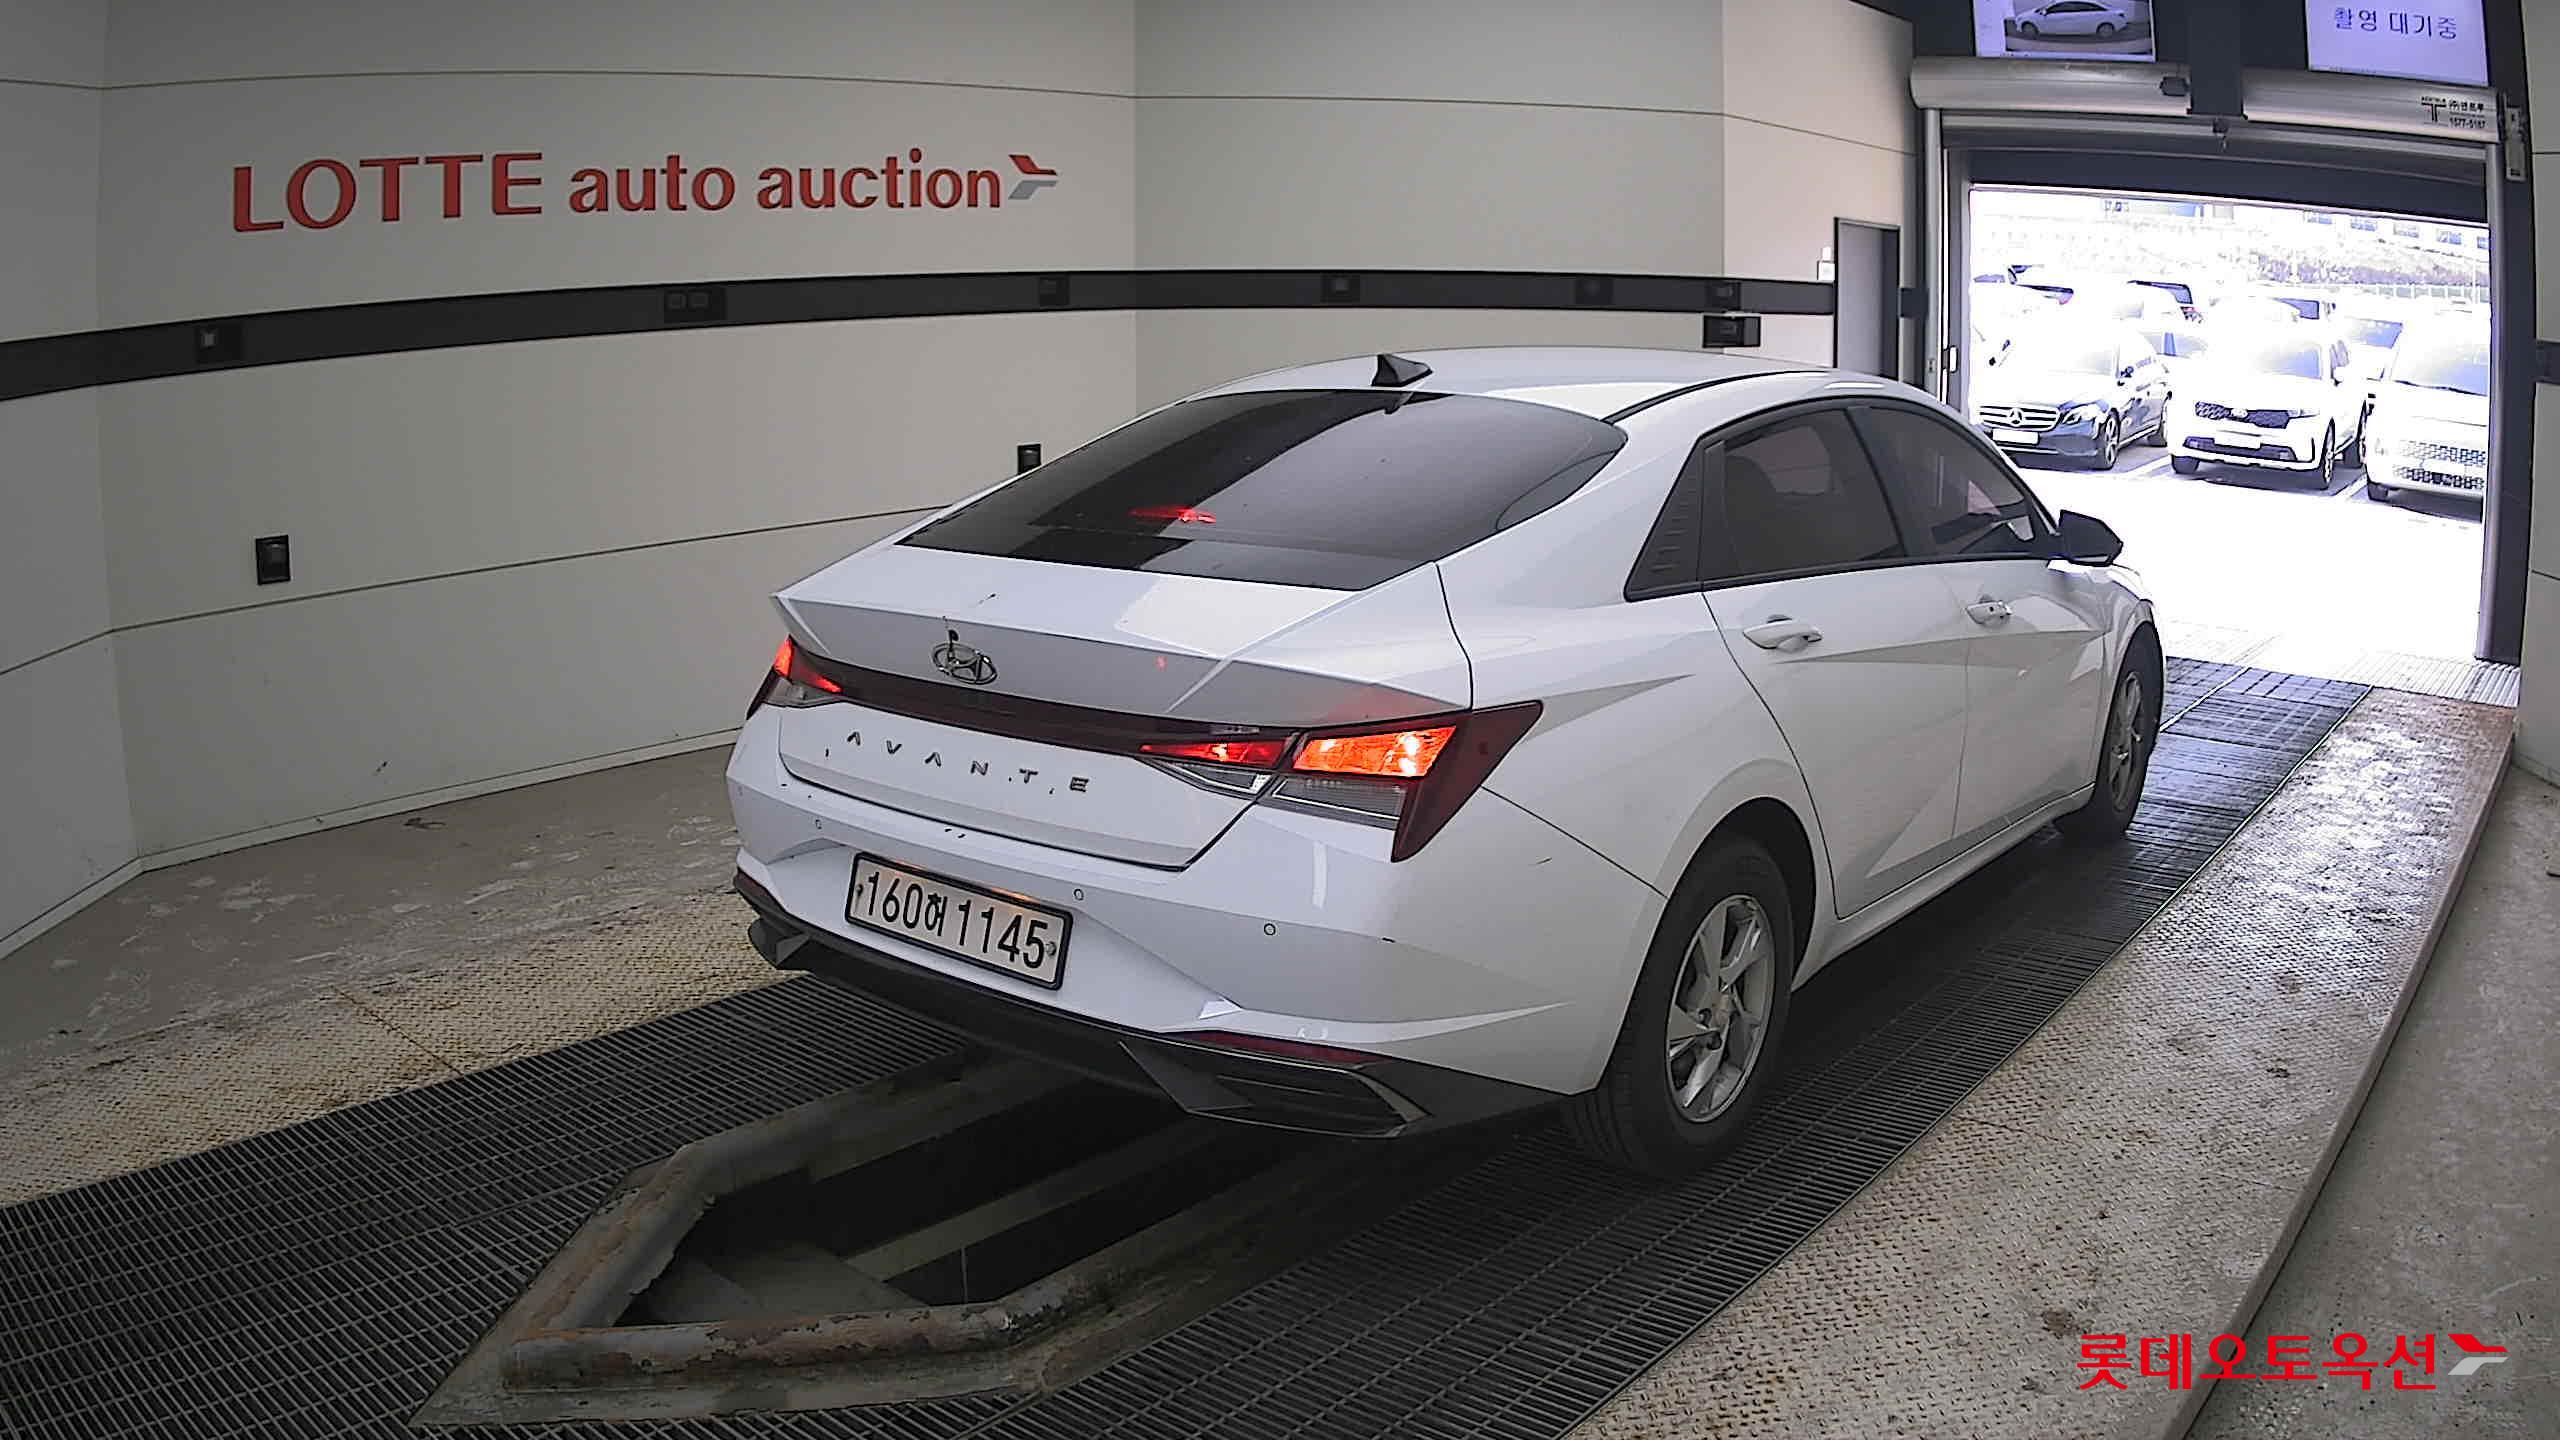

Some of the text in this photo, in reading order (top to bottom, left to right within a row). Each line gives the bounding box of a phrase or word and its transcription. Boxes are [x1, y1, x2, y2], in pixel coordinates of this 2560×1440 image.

[233, 148, 1000, 233] LOTTE auto auction
[847, 731, 1089, 793] AVANTE
